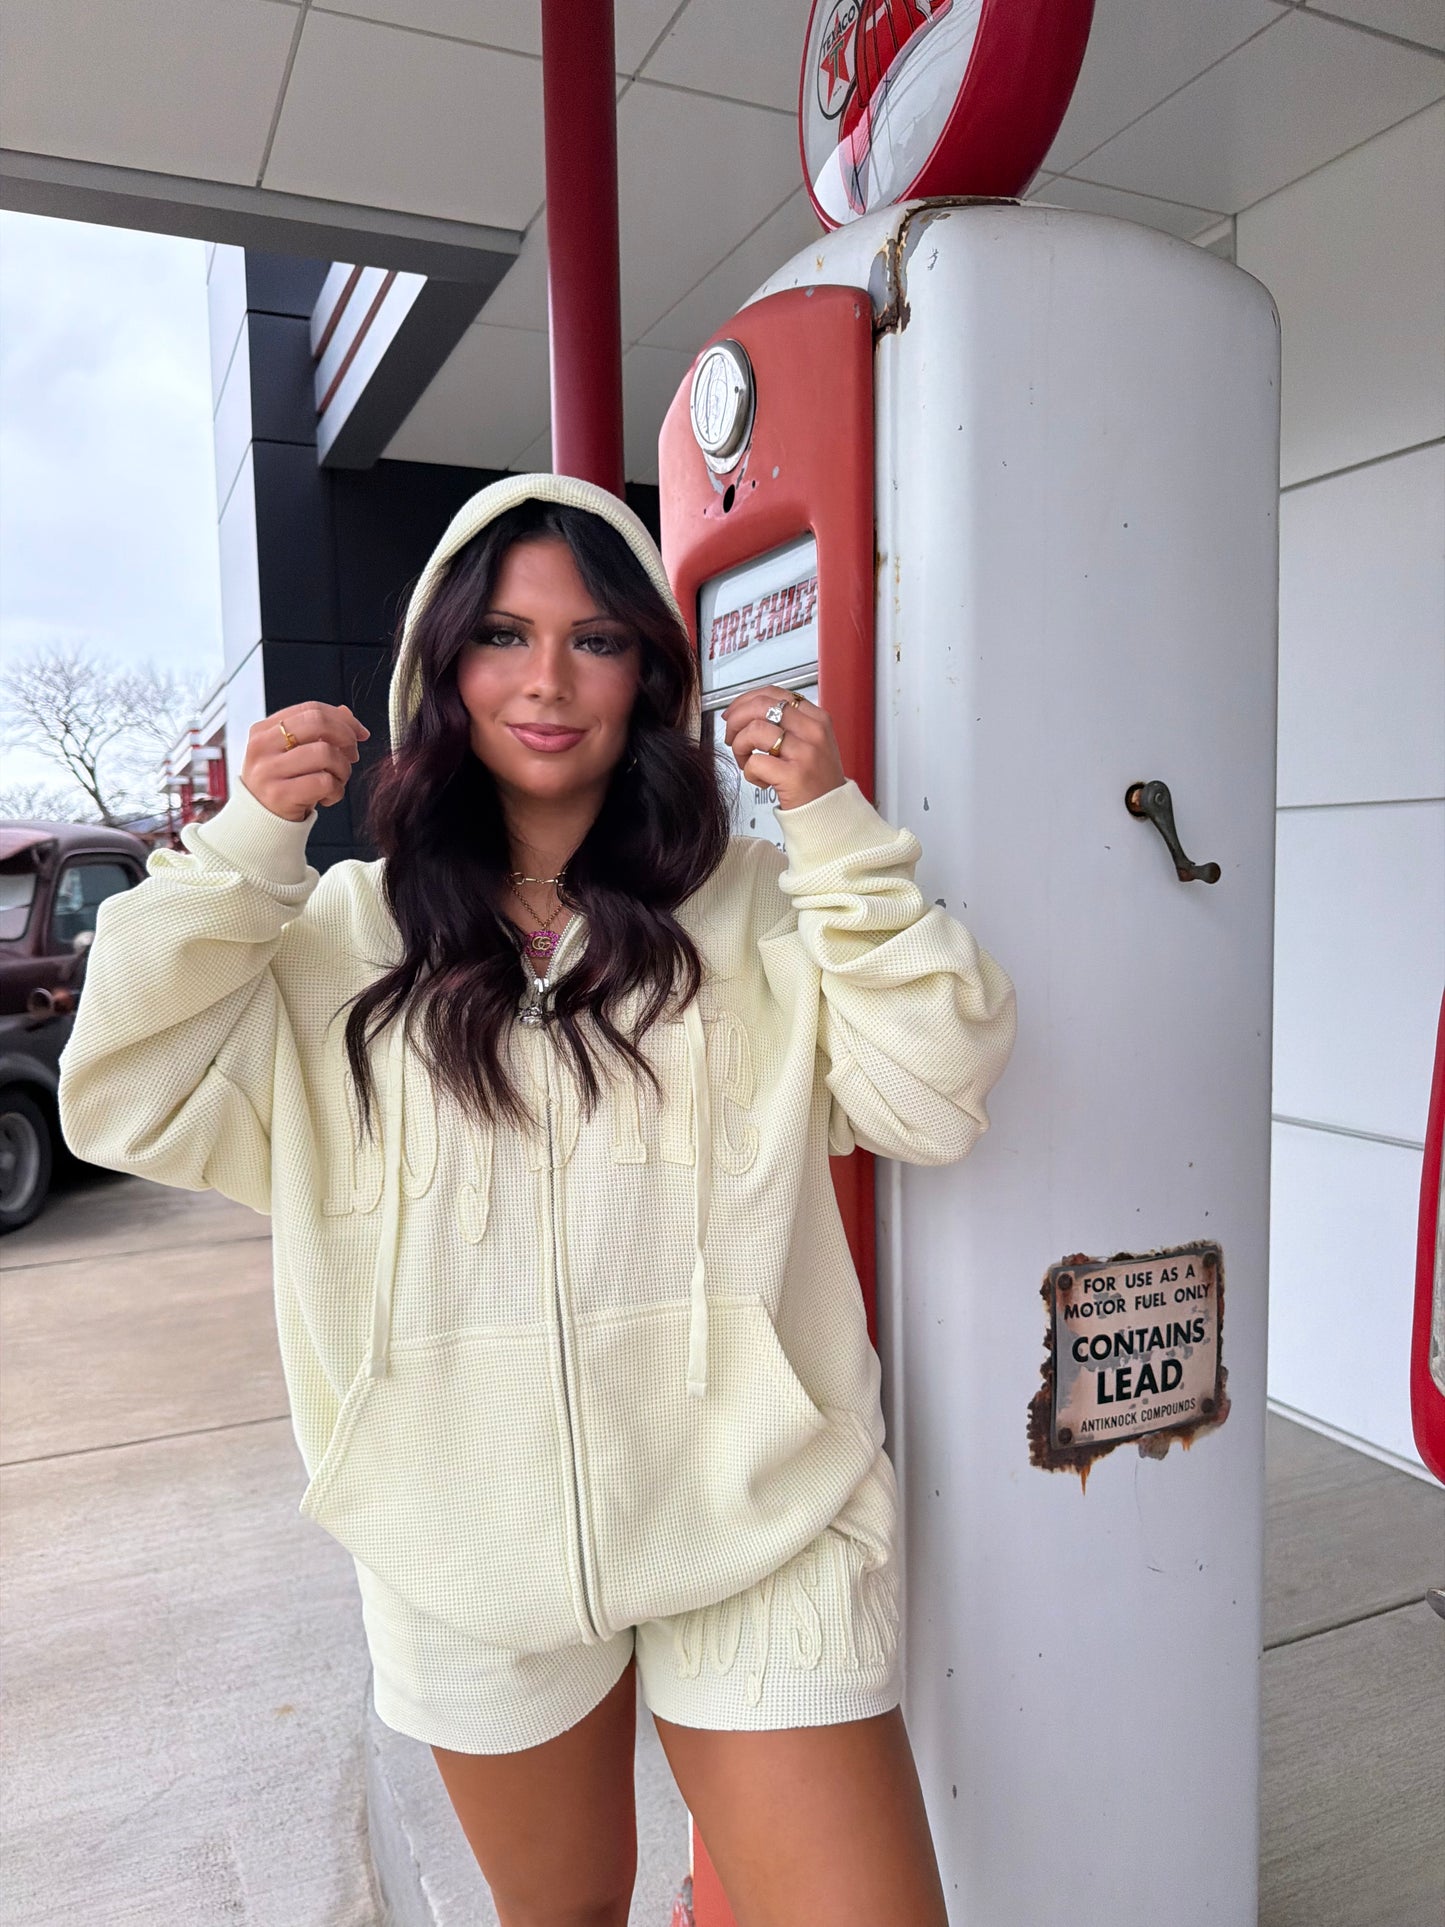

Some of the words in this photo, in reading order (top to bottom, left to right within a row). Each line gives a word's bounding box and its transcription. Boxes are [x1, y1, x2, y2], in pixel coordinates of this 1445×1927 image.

[821, 5, 856, 59] TEXACO
[754, 786, 777, 805] AMO
[1083, 1276, 1116, 1294] FOR
[1125, 1271, 1153, 1289] USE
[1160, 1267, 1178, 1284] AS
[1185, 1264, 1196, 1279] A
[1064, 1298, 1126, 1320] MOTOR
[1135, 1292, 1166, 1311] FUEL
[1174, 1283, 1211, 1303] ONLY
[1072, 1317, 1205, 1363] CONTAINS
[1097, 1359, 1183, 1405] LEAD
[1080, 1412, 1137, 1433] ANTIKNOCK
[1141, 1397, 1196, 1421] COMPOUNDS
